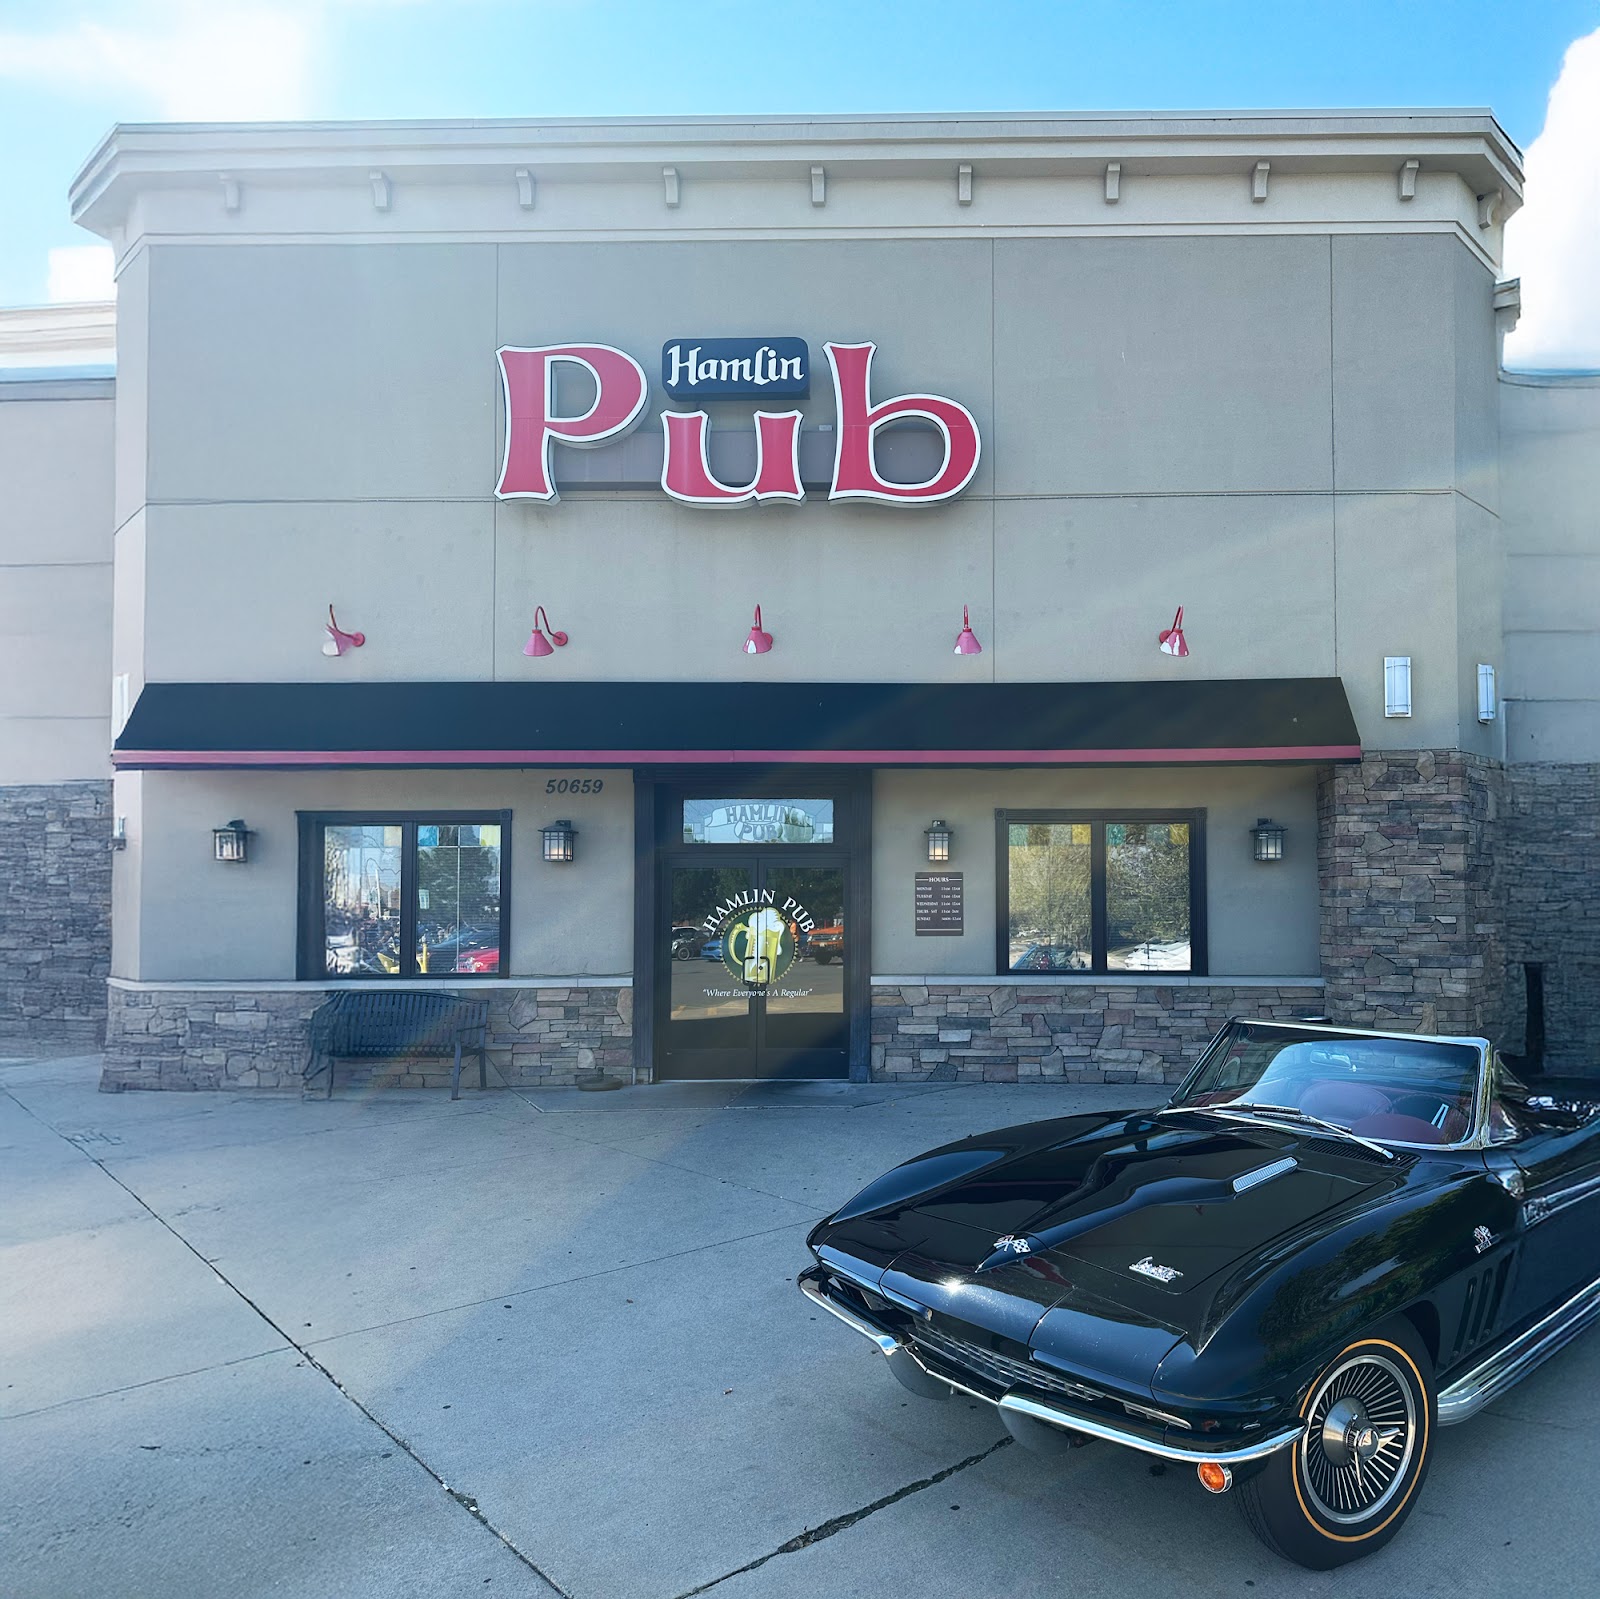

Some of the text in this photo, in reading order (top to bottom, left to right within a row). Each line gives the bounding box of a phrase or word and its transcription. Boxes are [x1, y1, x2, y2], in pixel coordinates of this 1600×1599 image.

[666, 344, 805, 387] Hamlin
[493, 340, 982, 504] Pub
[545, 779, 604, 794] 50659
[725, 804, 793, 824] HAMLIN
[740, 822, 777, 841] PUB
[702, 888, 816, 934] HAMLIN PUB
[732, 988, 771, 998] Everyone's
[772, 989, 779, 997] A
